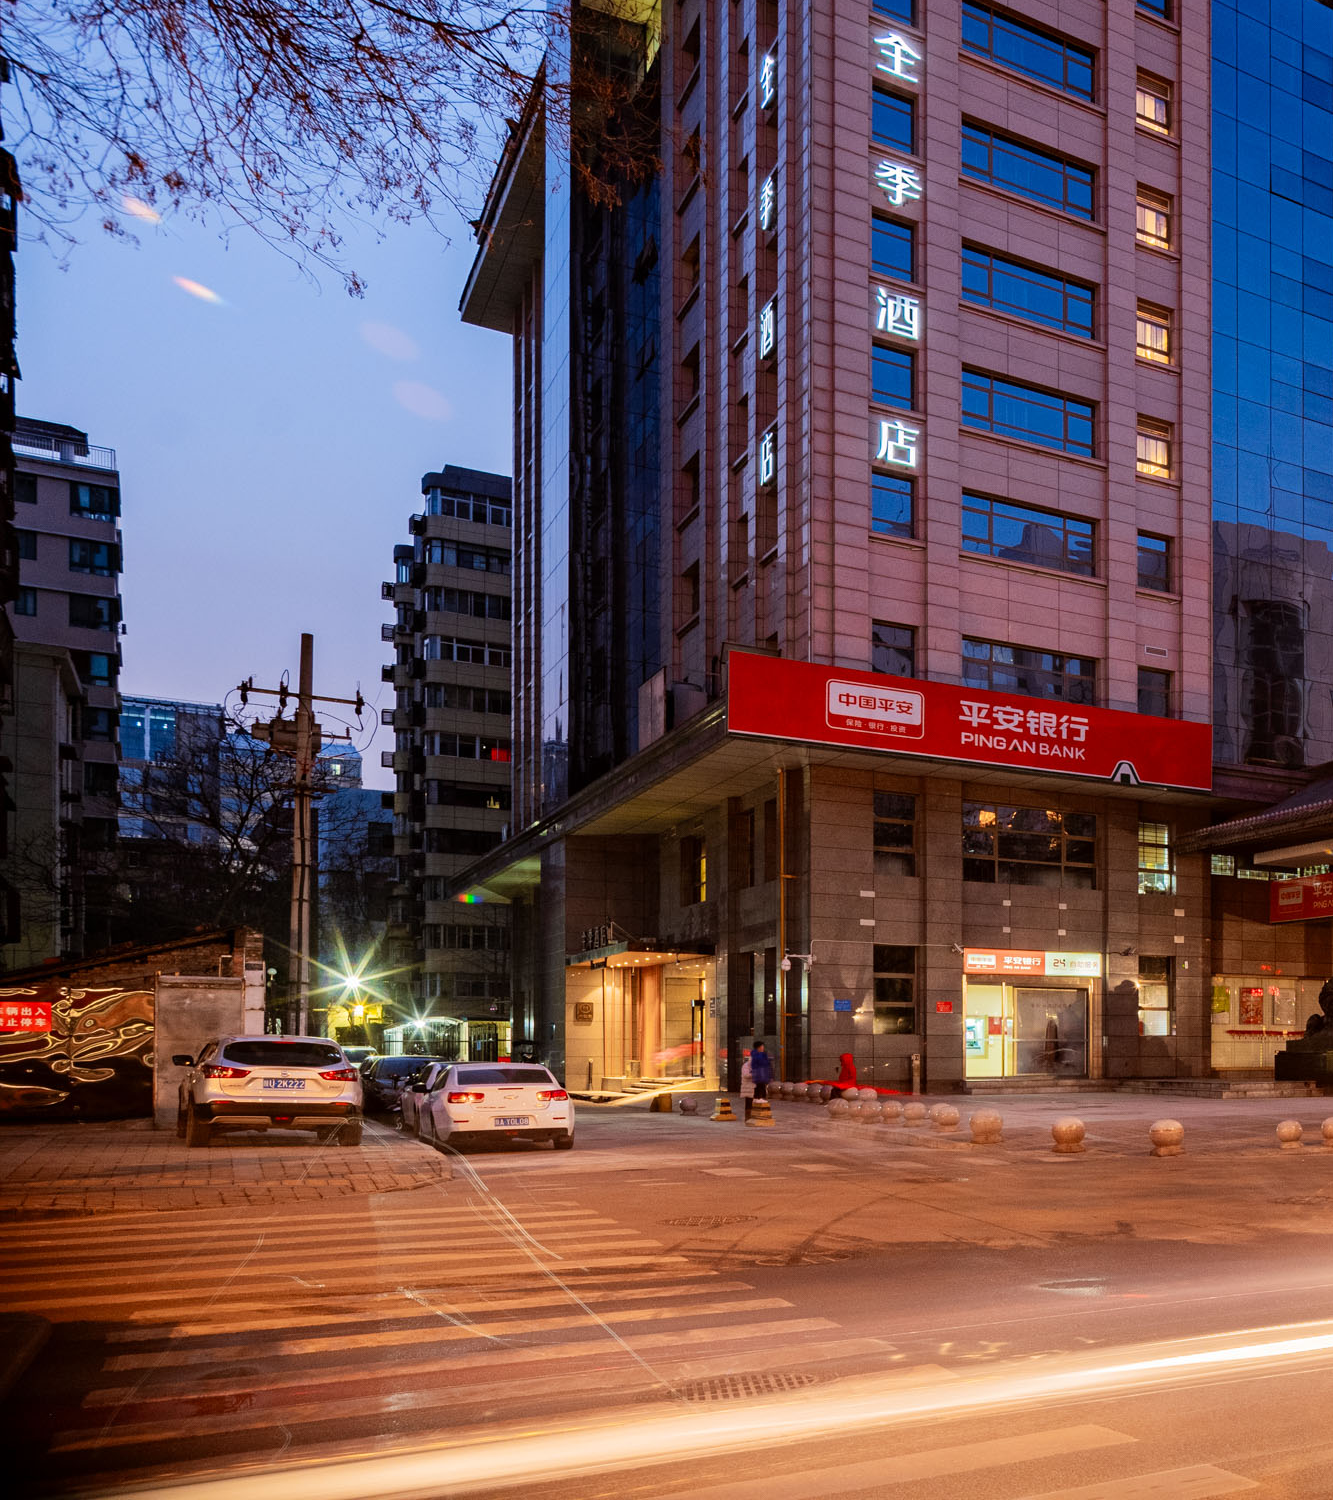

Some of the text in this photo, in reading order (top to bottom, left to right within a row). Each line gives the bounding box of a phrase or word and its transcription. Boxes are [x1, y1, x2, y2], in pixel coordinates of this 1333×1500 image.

[760, 53, 775, 487] 全季酒店
[873, 32, 923, 469] 全季酒店
[838, 693, 913, 715] 中国平安
[958, 700, 1090, 742] 平安银行
[1039, 742, 1086, 761] BANK
